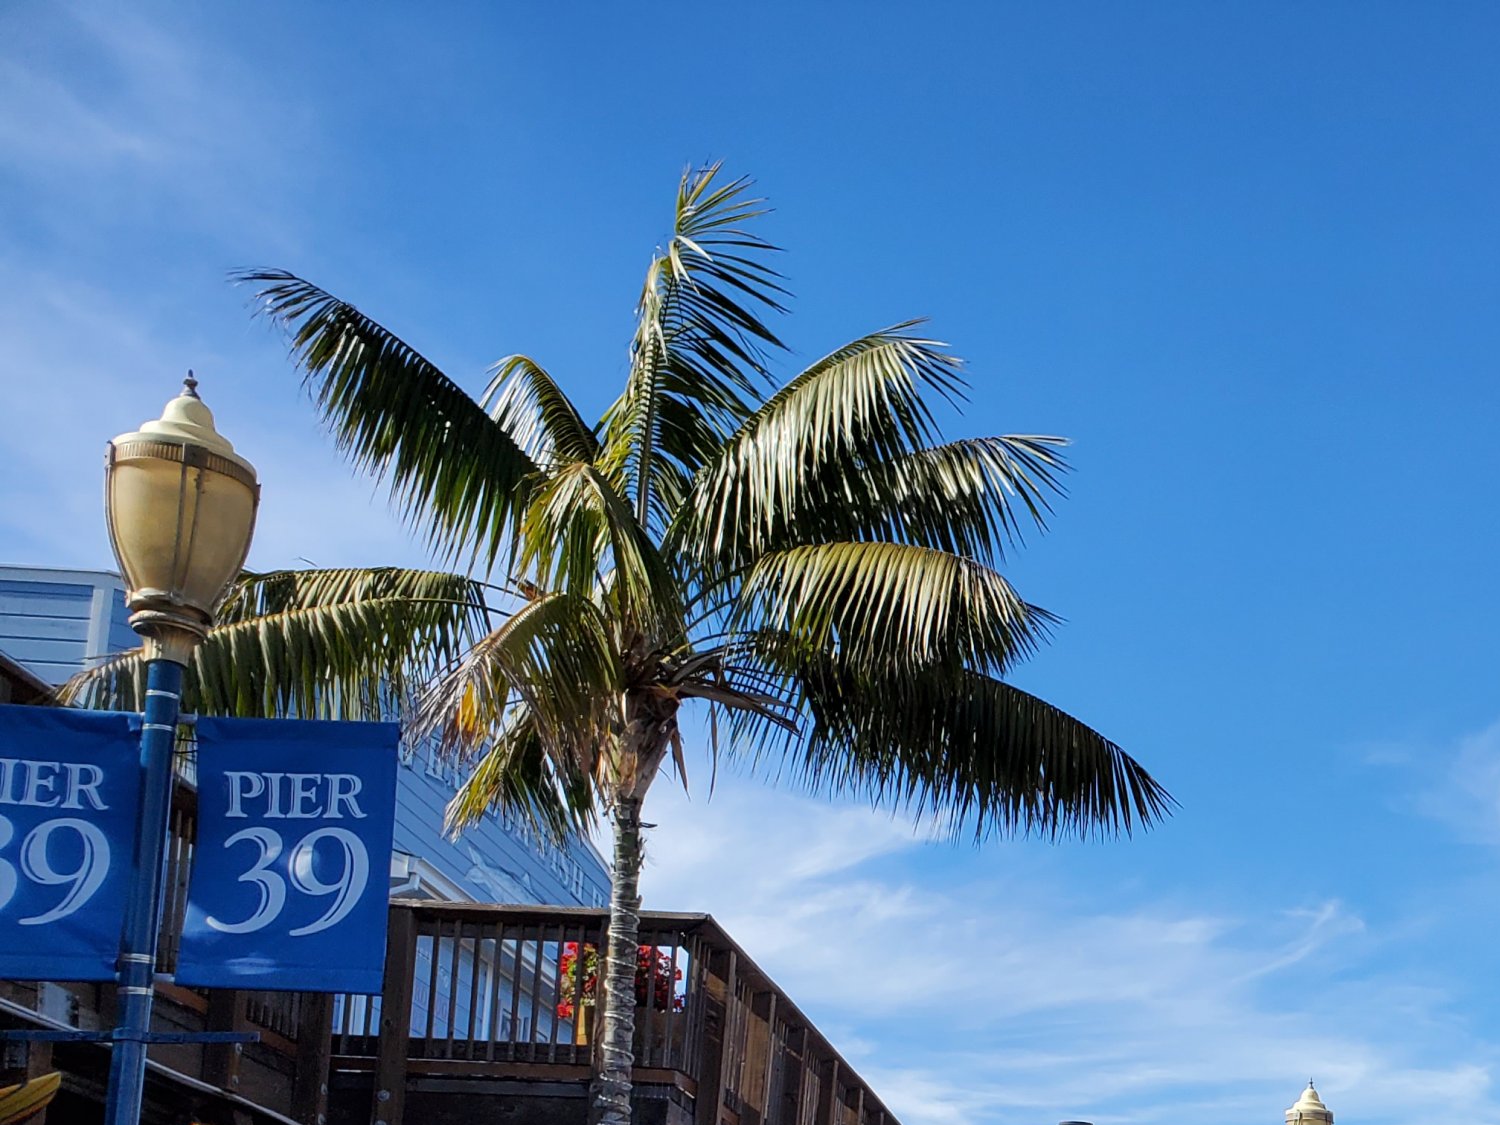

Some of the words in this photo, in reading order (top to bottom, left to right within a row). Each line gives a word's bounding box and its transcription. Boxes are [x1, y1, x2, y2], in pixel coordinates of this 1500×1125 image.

[0, 758, 109, 810] IER
[223, 770, 368, 819] PIER
[0, 814, 111, 925] 9
[206, 826, 370, 936] 39
